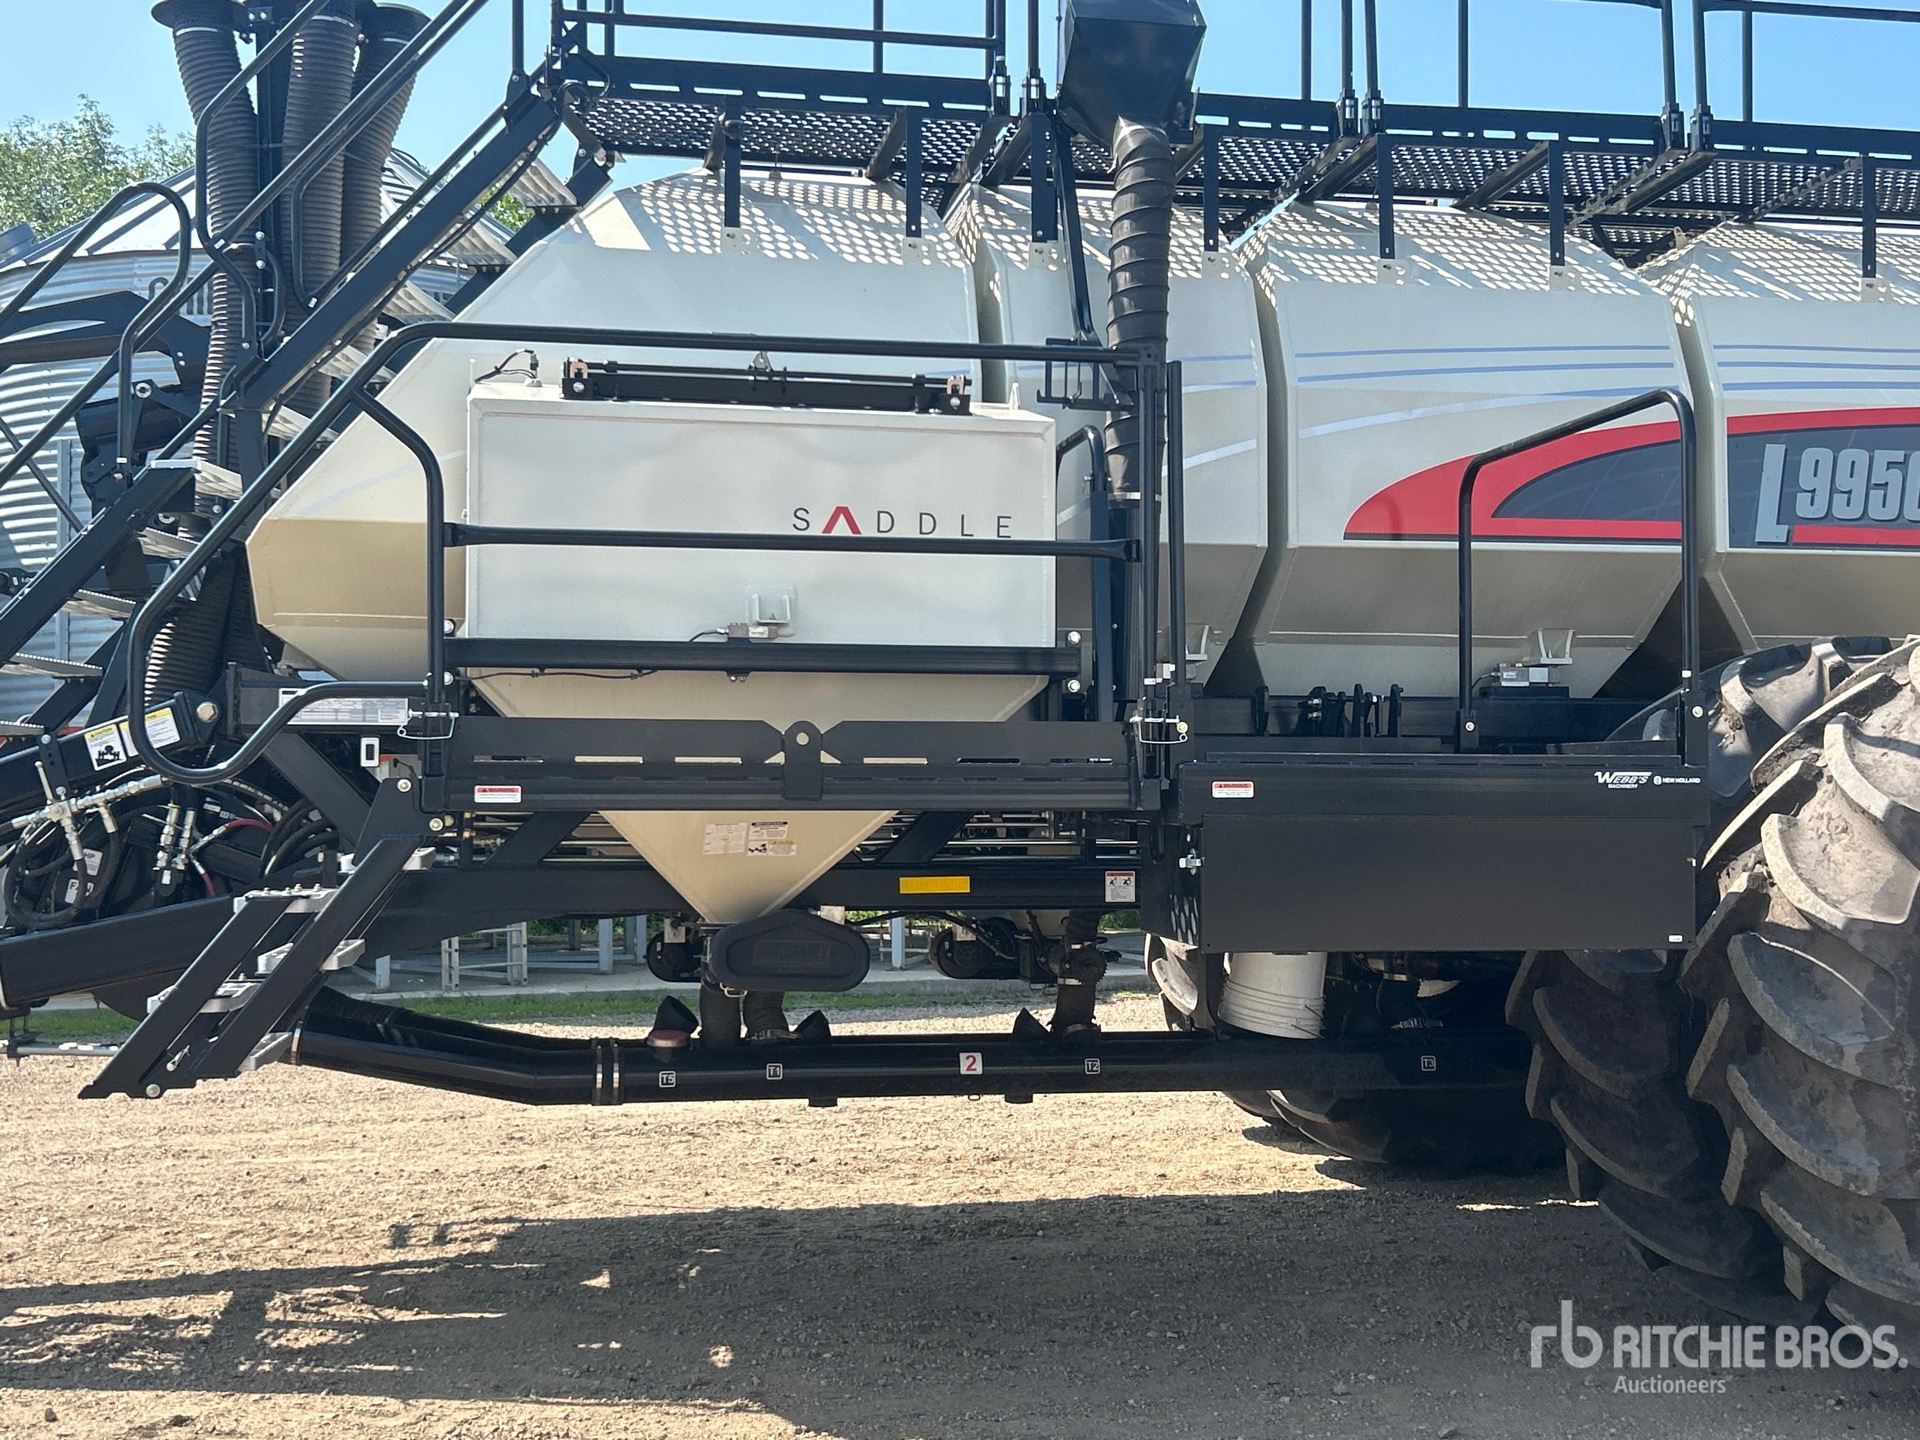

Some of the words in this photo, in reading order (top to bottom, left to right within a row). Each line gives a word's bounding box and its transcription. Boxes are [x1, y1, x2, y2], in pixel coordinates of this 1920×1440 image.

[792, 506, 1012, 538] SADDLE
[1593, 771, 1652, 784] WEBB'S
[965, 1055, 977, 1072] 2
[1087, 1061, 1099, 1071] T2
[1423, 1058, 1435, 1068] T3
[768, 1066, 780, 1076] T1
[661, 1074, 675, 1084] T5
